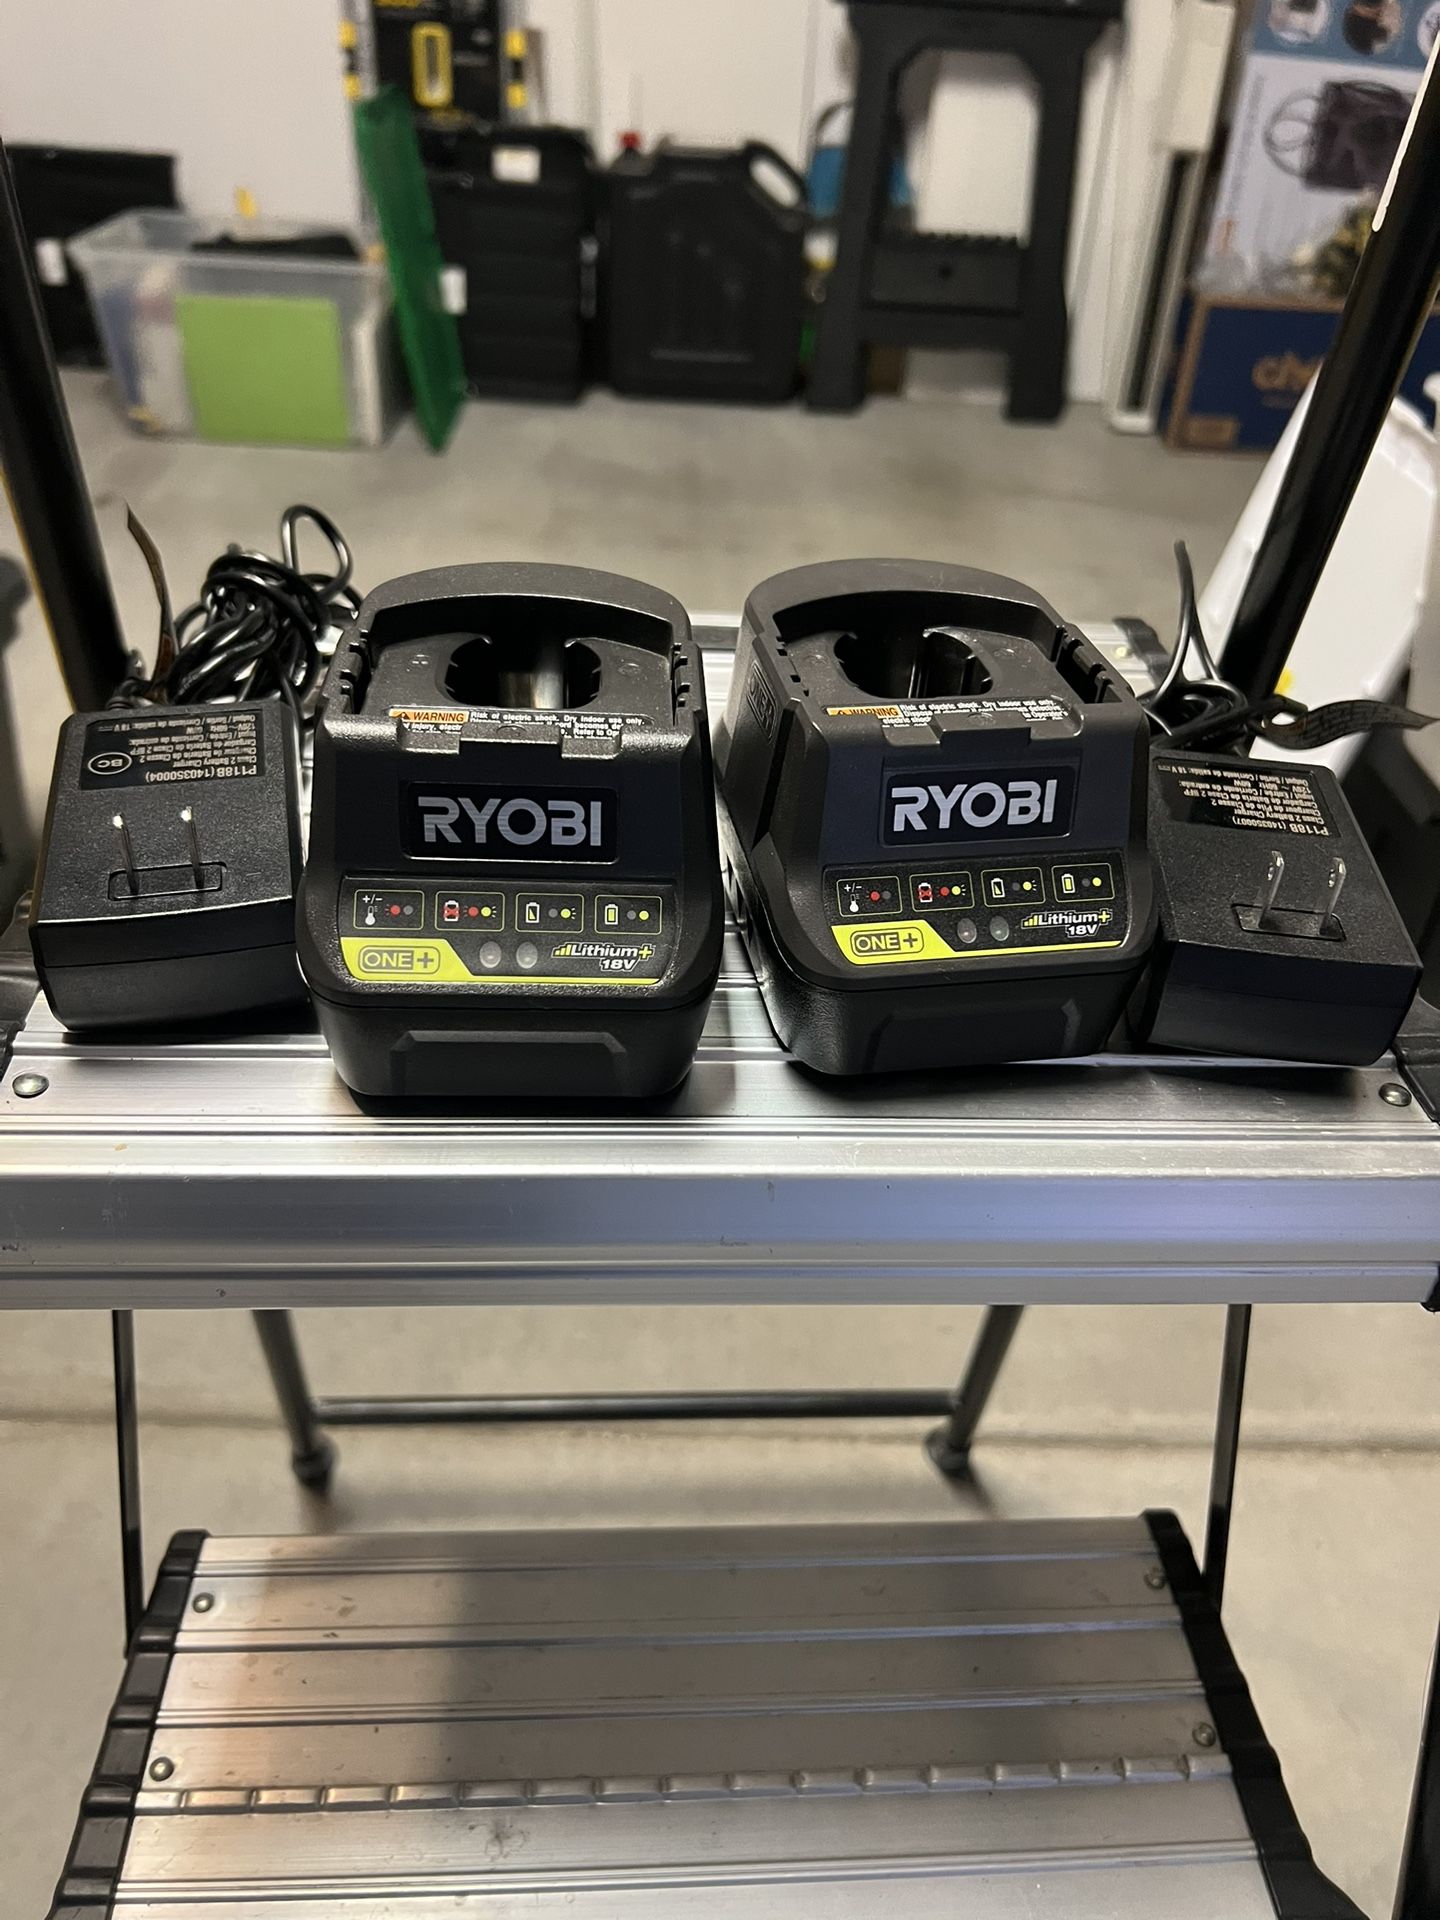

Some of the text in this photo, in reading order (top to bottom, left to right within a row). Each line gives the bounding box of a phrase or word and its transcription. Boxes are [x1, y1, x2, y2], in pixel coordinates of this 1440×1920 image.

[413, 712, 464, 722] WARNING
[564, 715, 577, 724] Dry
[97, 759, 123, 768] BC
[140, 755, 145, 763] 2
[173, 759, 202, 767] Charger
[146, 765, 257, 783] P118B (140350004)
[891, 779, 1058, 832] RYOBI
[1211, 798, 1217, 806] 2
[1234, 808, 1264, 818] Charger
[1266, 811, 1294, 821] Battery
[418, 796, 603, 847] RYOBI
[1302, 816, 1324, 824] Class
[1232, 816, 1329, 836] P118B (140350007)
[1038, 911, 1110, 926] Lithium+
[1067, 924, 1097, 936] 18V
[855, 933, 918, 952] ONE+
[571, 944, 652, 959] Lithium+
[364, 951, 435, 969] ONE+
[601, 959, 636, 970] 18V
